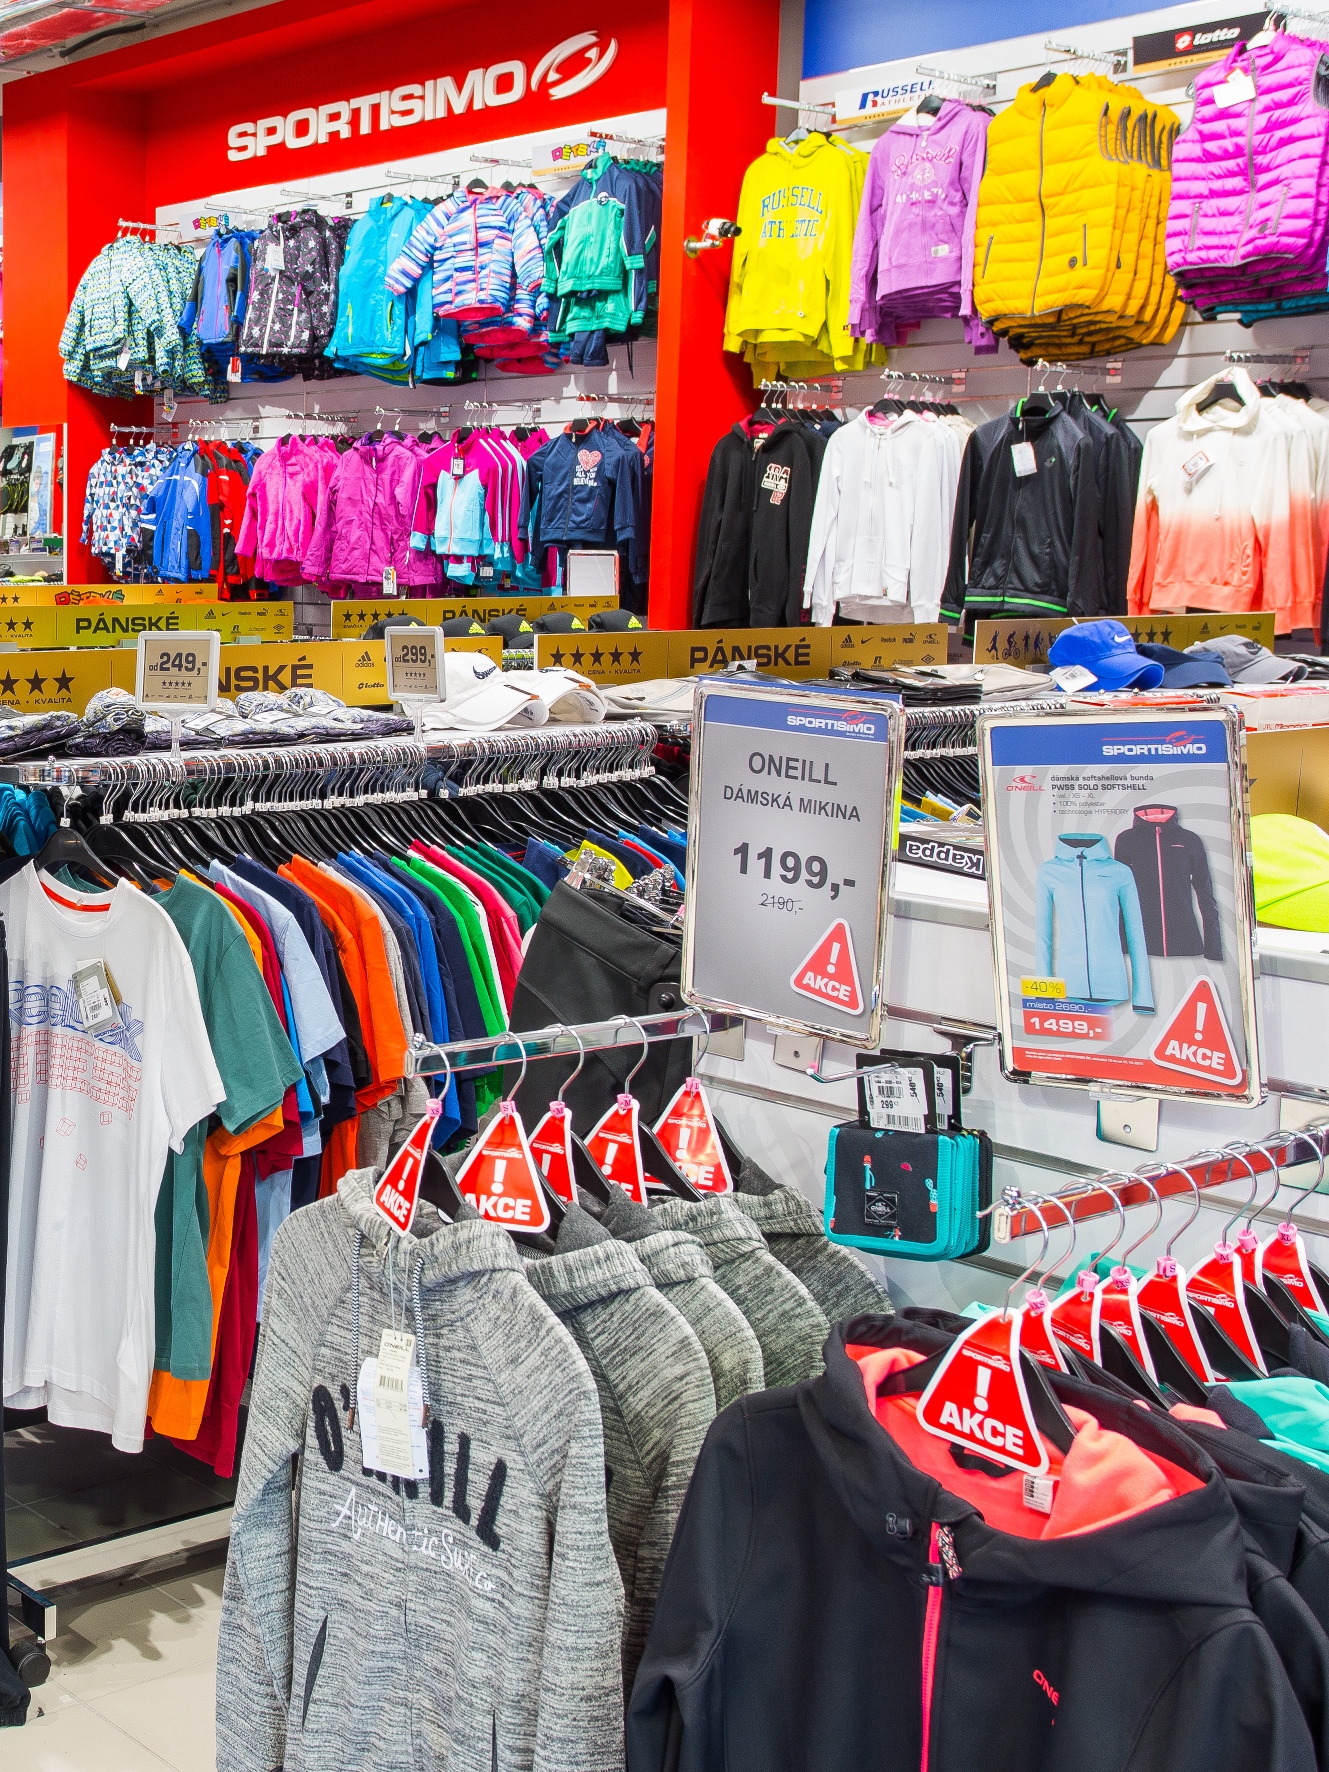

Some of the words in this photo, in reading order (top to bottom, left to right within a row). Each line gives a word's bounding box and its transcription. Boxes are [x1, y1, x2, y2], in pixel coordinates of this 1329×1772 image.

[1194, 28, 1241, 45] lotto
[859, 80, 935, 110] RUSSELL
[228, 60, 524, 163] SPORTISIMO
[761, 219, 820, 238] ATHETIC
[75, 611, 180, 634] PÁNSKÉ
[148, 662, 159, 672] od
[159, 651, 208, 676] 249,-
[394, 654, 402, 663] od
[401, 645, 435, 667] 299,-
[689, 637, 811, 670] PÁNSKÉ
[218, 655, 314, 693] NSKÉ
[34, 697, 73, 705] KVALITA
[786, 715, 875, 735] SPORTISIMO
[1102, 743, 1207, 756] SPORTISIMO
[748, 751, 838, 786] ONEILL
[1050, 774, 1080, 782] dámská
[1082, 774, 1128, 782] softshellová
[1130, 774, 1154, 782] bunda
[1077, 783, 1099, 791] SOLO
[1100, 783, 1147, 791] SOFTSHELL
[723, 784, 794, 812] DÁMSKÁ
[798, 797, 861, 822] MIKINA
[1058, 808, 1093, 816] technologie
[1079, 800, 1107, 808] polyester
[906, 840, 983, 875] Kappa
[733, 842, 856, 901] 1199,-
[759, 892, 804, 916] 2190,-
[802, 971, 852, 1002] AKCE
[1024, 981, 1062, 994] -40%
[1026, 1001, 1054, 1011] místo
[1055, 1002, 1092, 1013] 2690,-
[1029, 1016, 1103, 1038] 1499,-
[1164, 1039, 1226, 1071] AKCE
[880, 1100, 894, 1110] 299
[379, 1184, 411, 1224] AKCE
[464, 1193, 532, 1221] AKCE
[1280, 1233, 1292, 1242] XL
[1220, 1253, 1230, 1261] M
[1170, 1264, 1176, 1273] S
[962, 1348, 1011, 1373] SPORTISIMO
[939, 1400, 1024, 1456] AKCE
